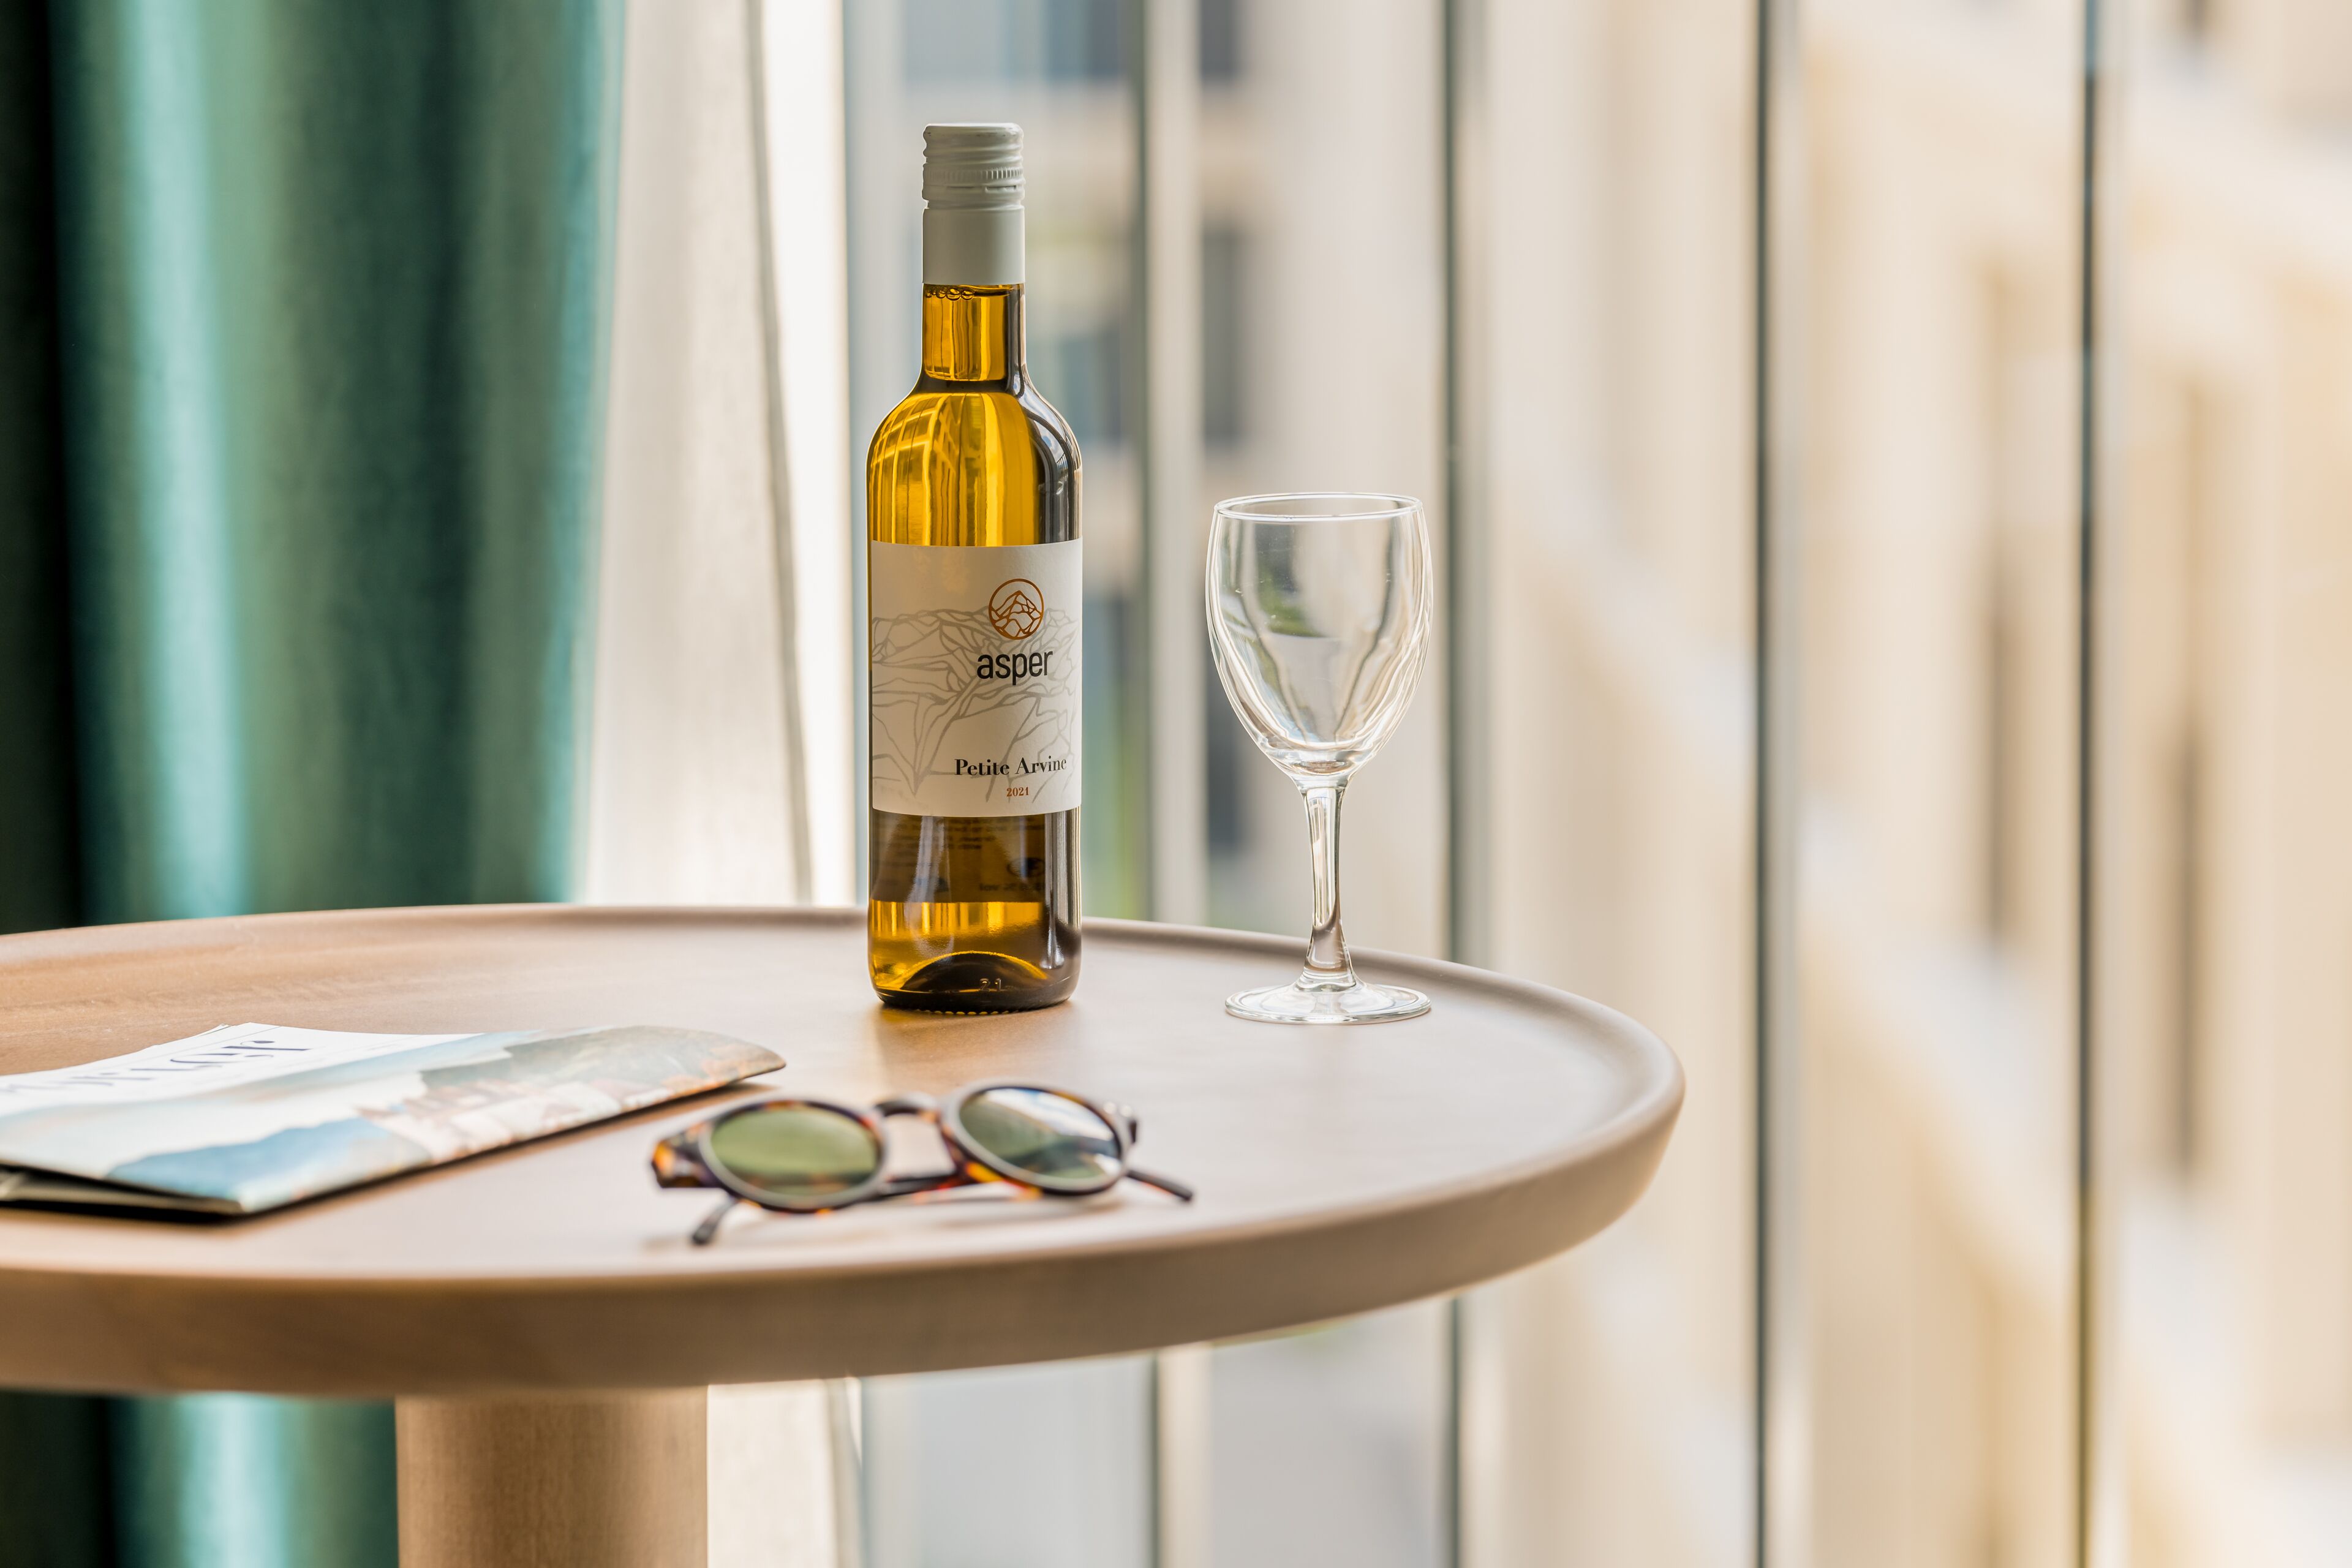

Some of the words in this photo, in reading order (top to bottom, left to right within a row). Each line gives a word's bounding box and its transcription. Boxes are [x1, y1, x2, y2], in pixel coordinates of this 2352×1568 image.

[976, 650, 1053, 686] asper
[954, 758, 1010, 776] Petite
[1014, 755, 1067, 775] Arvine
[1006, 786, 1030, 797] 2021
